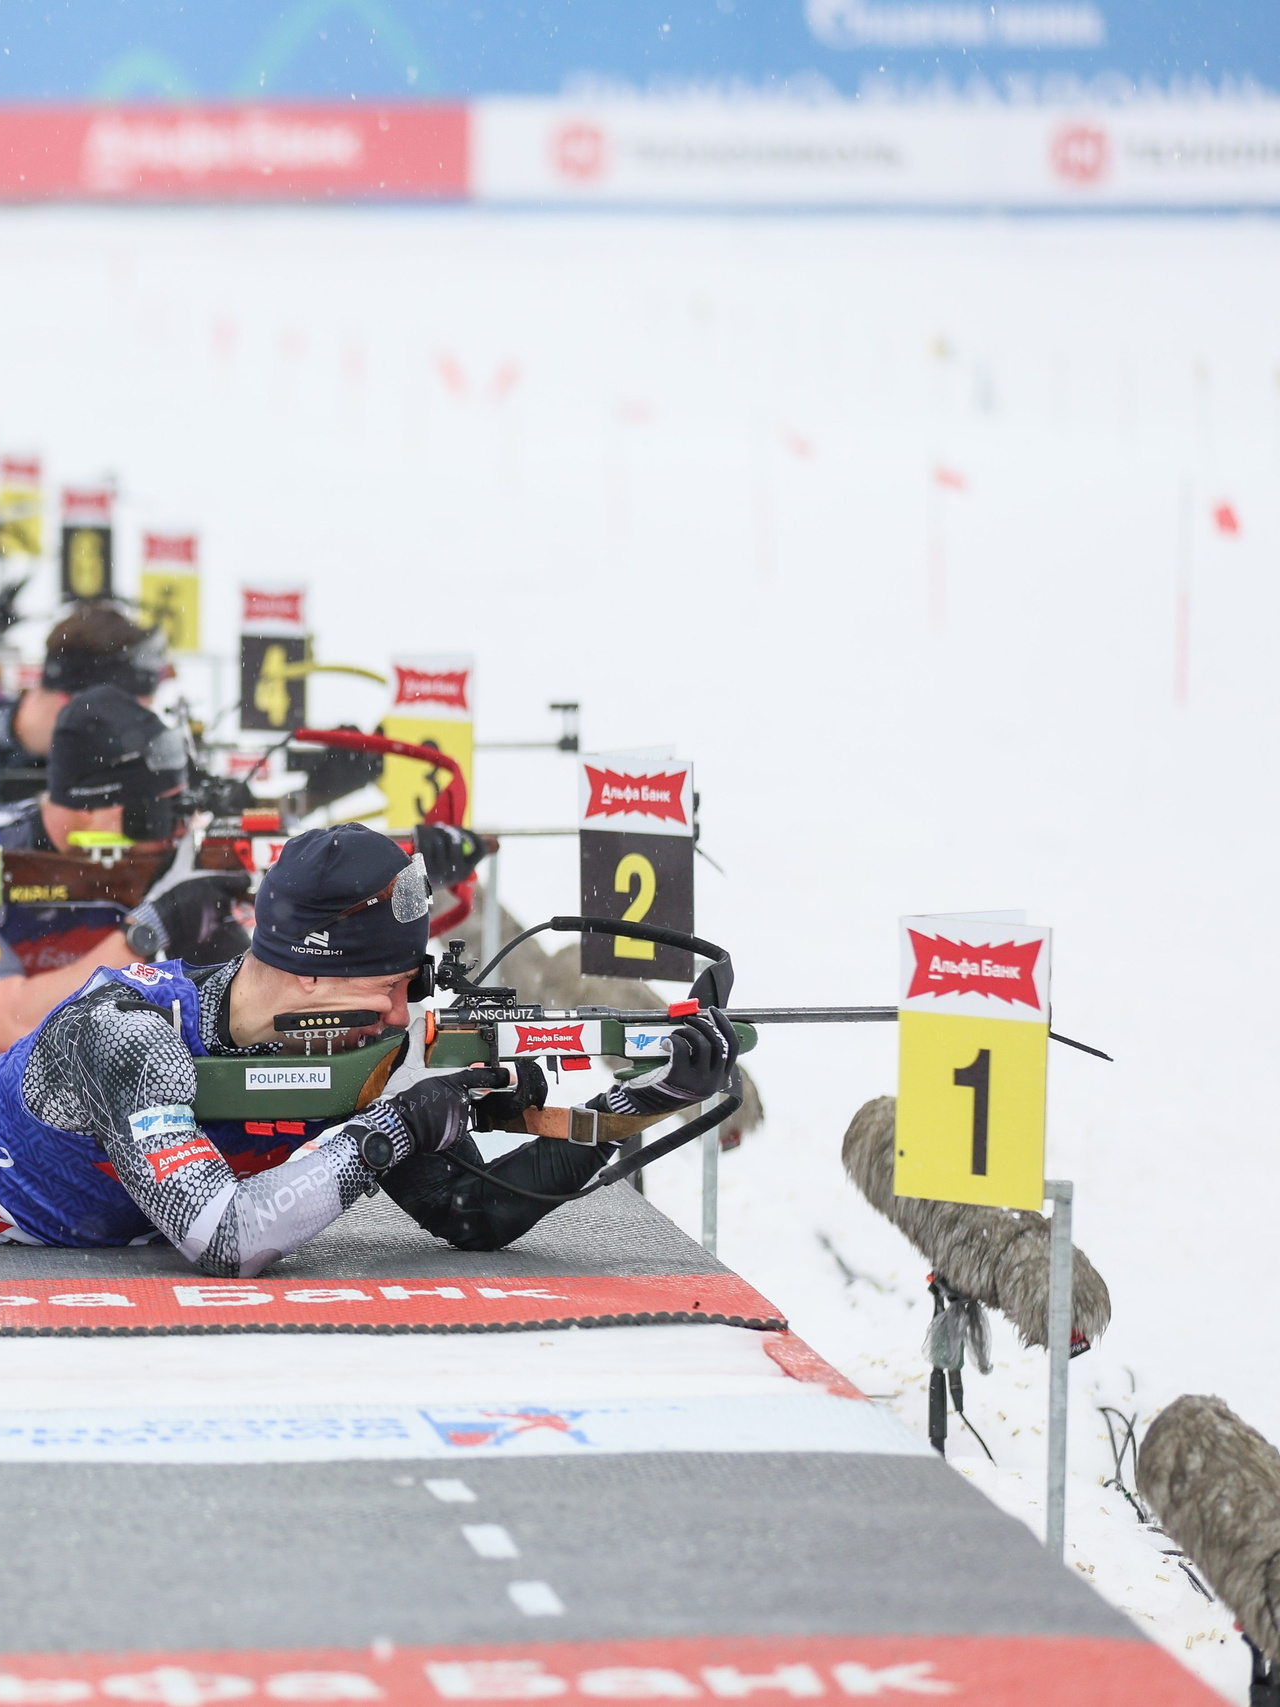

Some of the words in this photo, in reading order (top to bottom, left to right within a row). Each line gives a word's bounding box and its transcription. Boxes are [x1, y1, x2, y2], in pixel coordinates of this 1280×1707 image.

[254, 644, 291, 727] 4
[601, 783, 640, 804] Альфа
[641, 787, 671, 803] Банк
[614, 853, 656, 960] 2
[291, 945, 343, 956] NORDSKI
[927, 956, 980, 981] Альфа
[981, 960, 1021, 979] Банк
[526, 1034, 553, 1045] Альфа
[553, 1034, 573, 1042] Банк
[250, 1072, 326, 1084] POLIPLEX.RU
[953, 1049, 990, 1176] 1
[158, 1150, 191, 1172] Альфа
[190, 1145, 213, 1155] Банк
[172, 1285, 570, 1308] Банк
[424, 1661, 960, 1700] Банк
